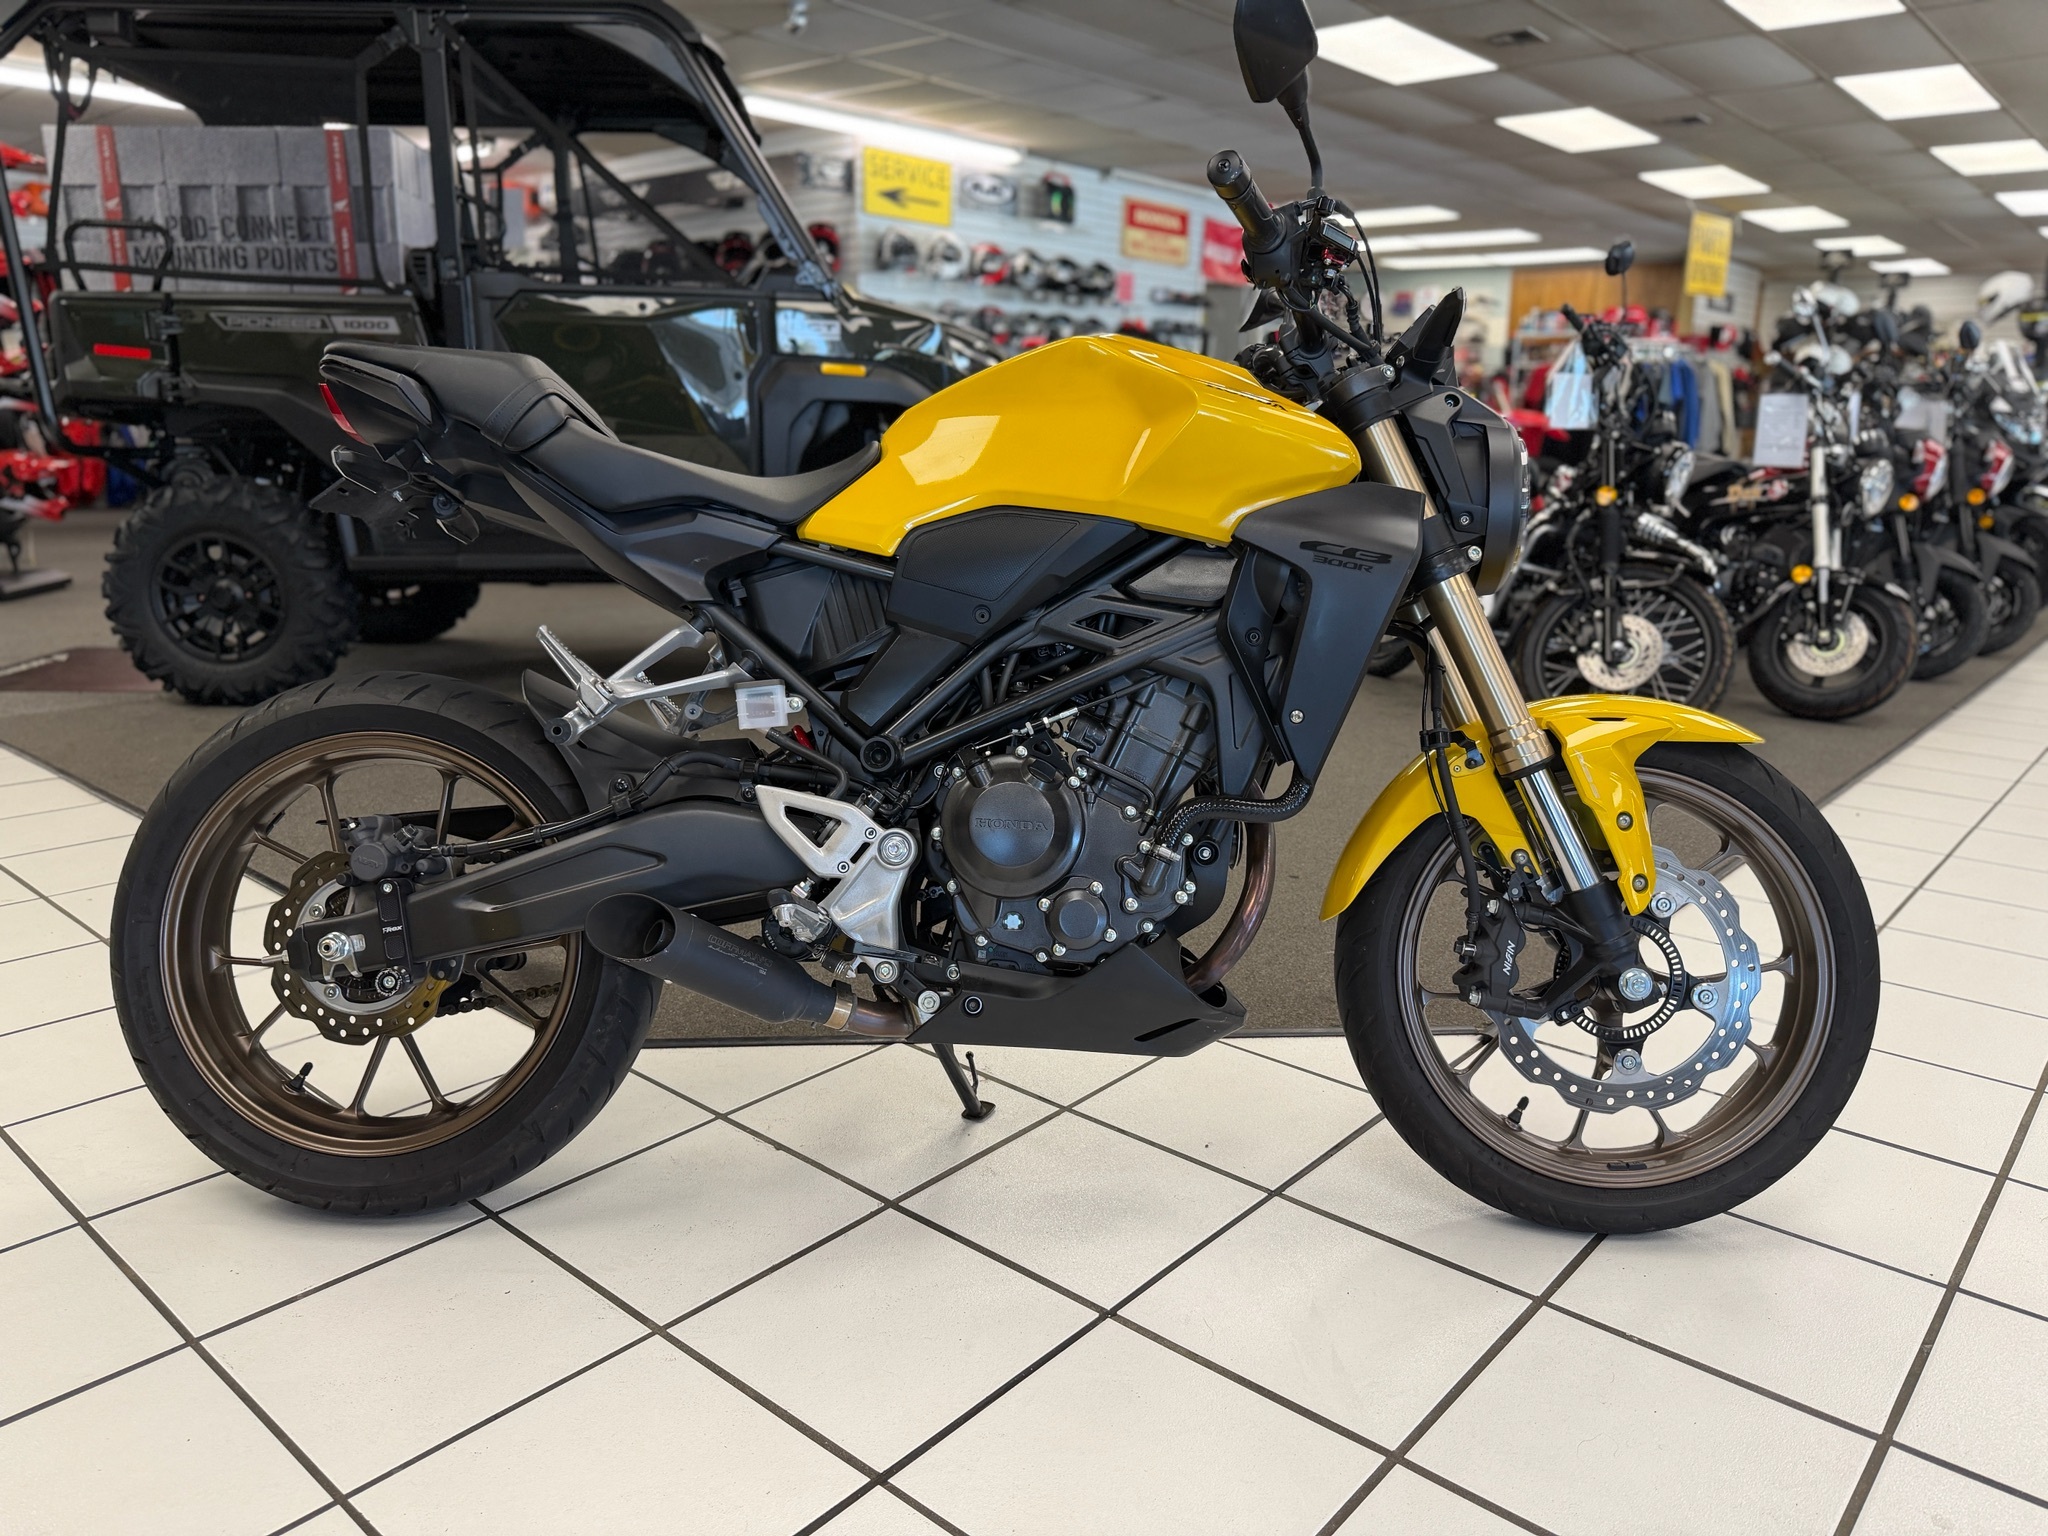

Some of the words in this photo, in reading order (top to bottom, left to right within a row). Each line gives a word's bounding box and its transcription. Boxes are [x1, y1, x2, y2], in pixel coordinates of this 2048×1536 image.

[870, 153, 950, 192] SERVICE
[257, 246, 339, 273] POINTS
[343, 319, 390, 331] 1000
[1299, 541, 1393, 565] CB
[1312, 554, 1374, 573] 300R
[974, 817, 1049, 831] HONDA
